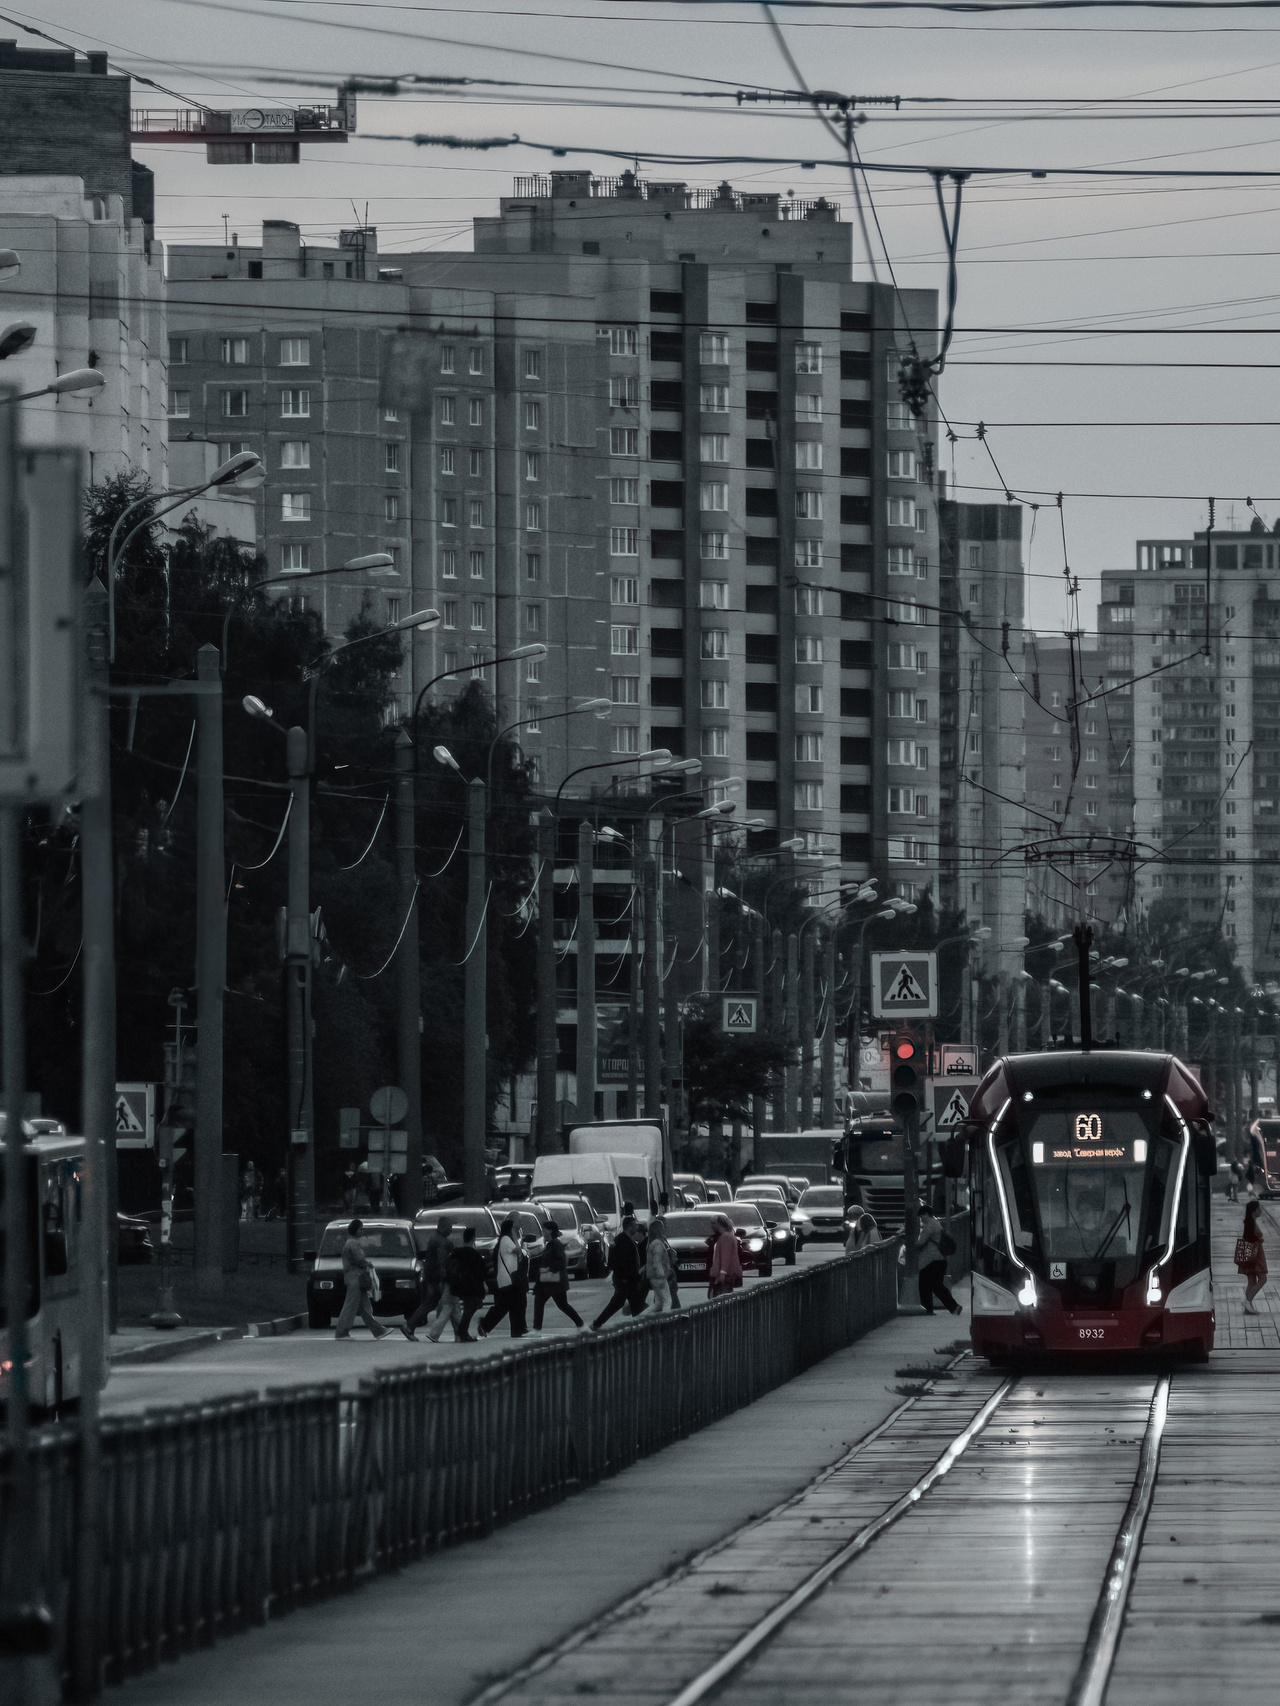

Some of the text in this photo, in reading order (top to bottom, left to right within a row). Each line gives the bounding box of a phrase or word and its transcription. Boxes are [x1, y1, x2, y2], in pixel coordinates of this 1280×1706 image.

[1076, 1114, 1102, 1140] 60
[1053, 1150, 1072, 1158] завод
[1079, 1329, 1104, 1339] 8932
